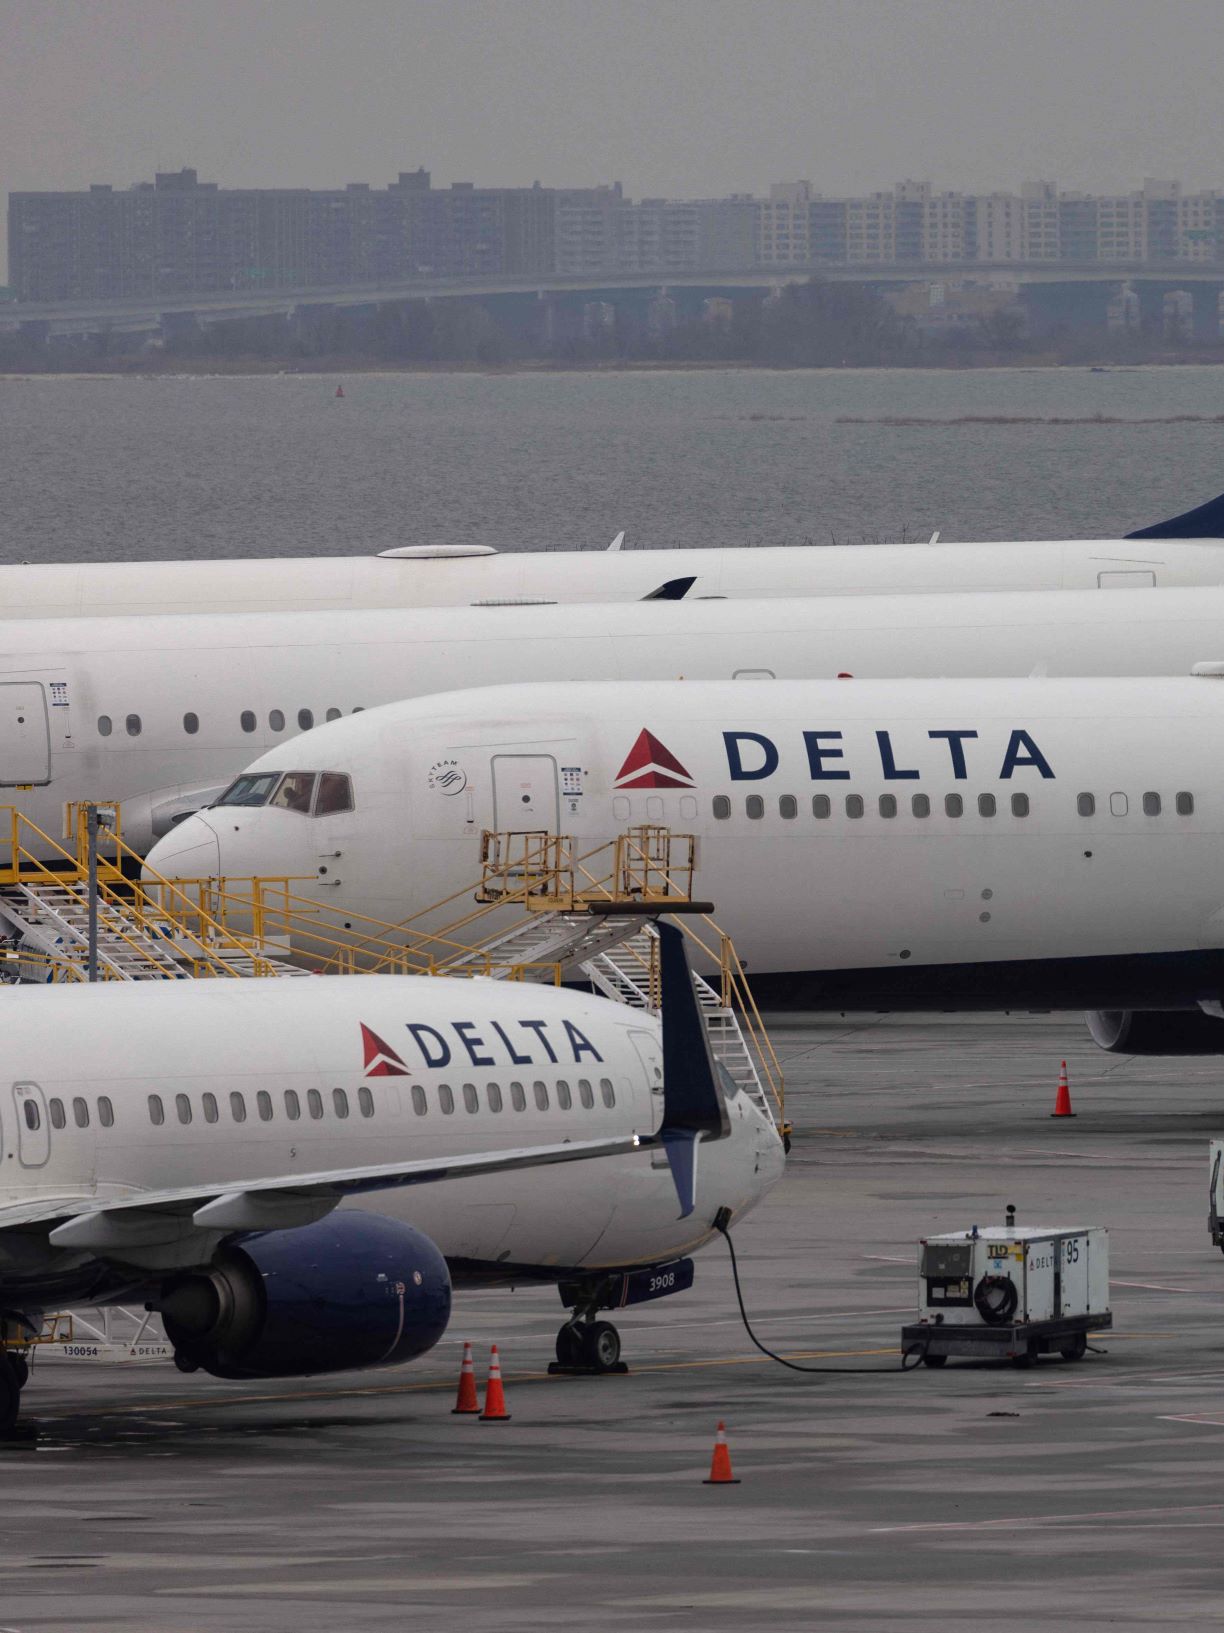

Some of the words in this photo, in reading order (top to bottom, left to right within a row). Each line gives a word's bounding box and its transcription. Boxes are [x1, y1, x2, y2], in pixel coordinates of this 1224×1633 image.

[722, 729, 1056, 781] DELTA
[428, 759, 458, 789] SKYTEAM
[405, 1020, 604, 1068] DELTA
[988, 1244, 1008, 1256] TLD
[1067, 1239, 1079, 1264] 95
[649, 1272, 675, 1291] 3908
[64, 1346, 98, 1356] 130054
[138, 1347, 167, 1355] DELTA
